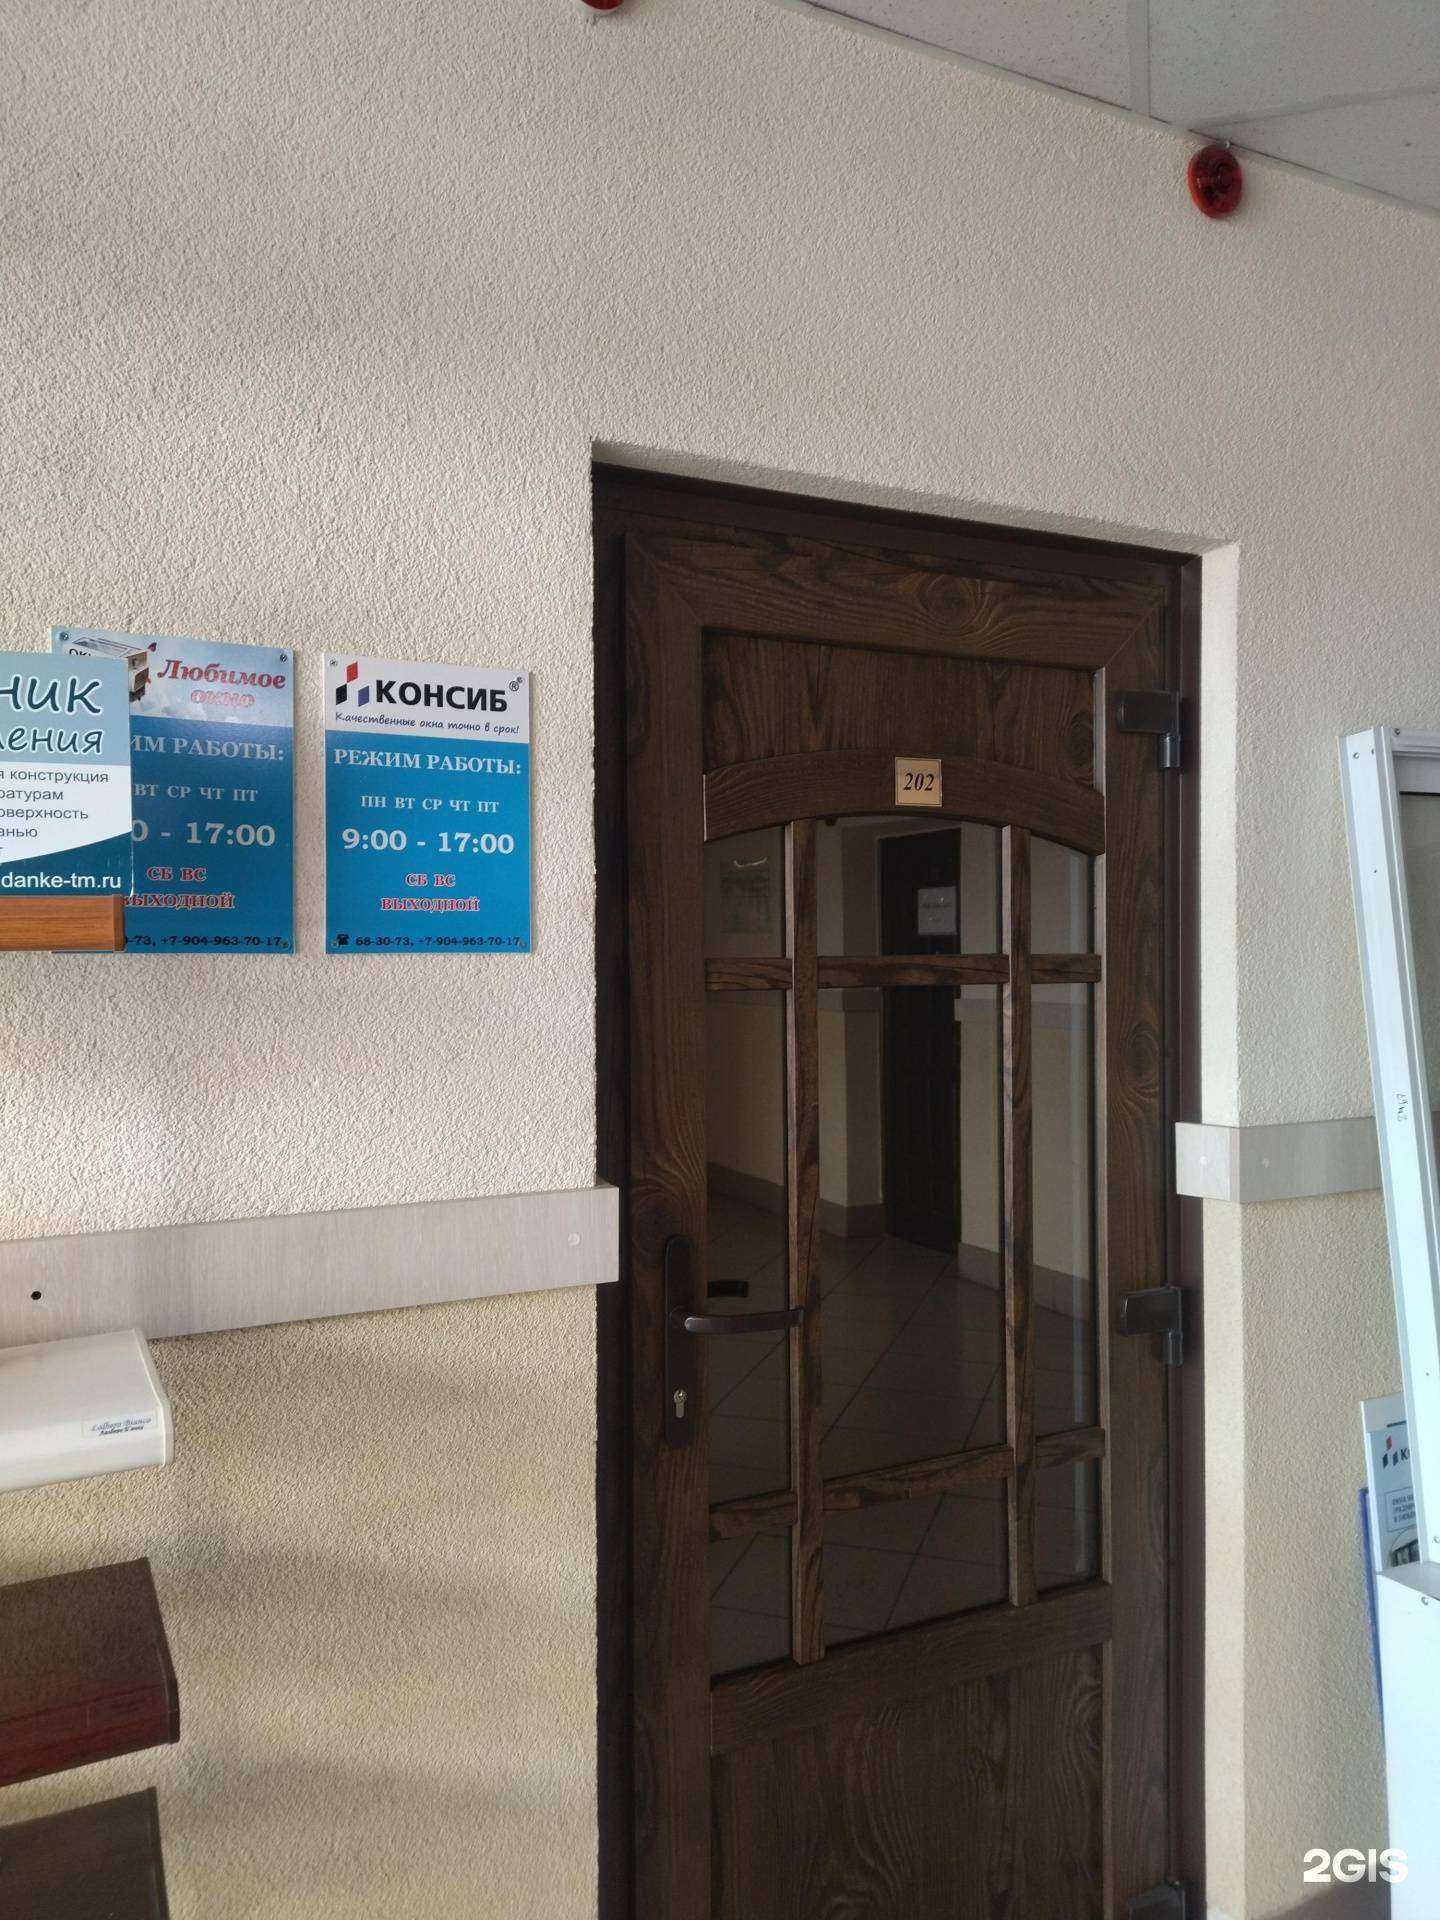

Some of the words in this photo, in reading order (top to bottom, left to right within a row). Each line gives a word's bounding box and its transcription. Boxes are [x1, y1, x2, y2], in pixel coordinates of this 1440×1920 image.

[157, 659, 286, 689] Любимое
[376, 679, 508, 713] КОНСИБ
[335, 712, 416, 727] Качественные
[419, 719, 444, 729] окна
[448, 722, 481, 732] точно
[484, 722, 490, 732] в
[493, 725, 520, 735] срок!
[0, 726, 104, 755] ения
[172, 737, 285, 761] РАБОТЫ:
[333, 749, 421, 769] РЕЖИМ
[427, 754, 522, 775] РАБОТЫ:
[10, 770, 110, 784] конструкция
[903, 772, 935, 792] 202
[134, 783, 159, 797] ВТ
[166, 785, 191, 798] СР
[199, 787, 225, 800] ЧТ
[233, 789, 258, 802] ПТ
[360, 795, 387, 808] ПН
[395, 797, 416, 809] ВТ
[422, 799, 442, 811] СР
[449, 800, 471, 811] ЧТ
[477, 801, 499, 813] ПТ
[186, 822, 276, 847] 17:00
[341, 828, 407, 851] 9:00
[437, 832, 515, 854] 17:00
[1, 871, 121, 889] danke-tm.ru
[147, 867, 173, 880] СБ
[180, 868, 207, 881] ВС
[405, 874, 428, 886] СБ
[434, 875, 456, 887] ВС
[381, 897, 480, 912] ВЫХОДНОЙ
[125, 936, 156, 947] -73,
